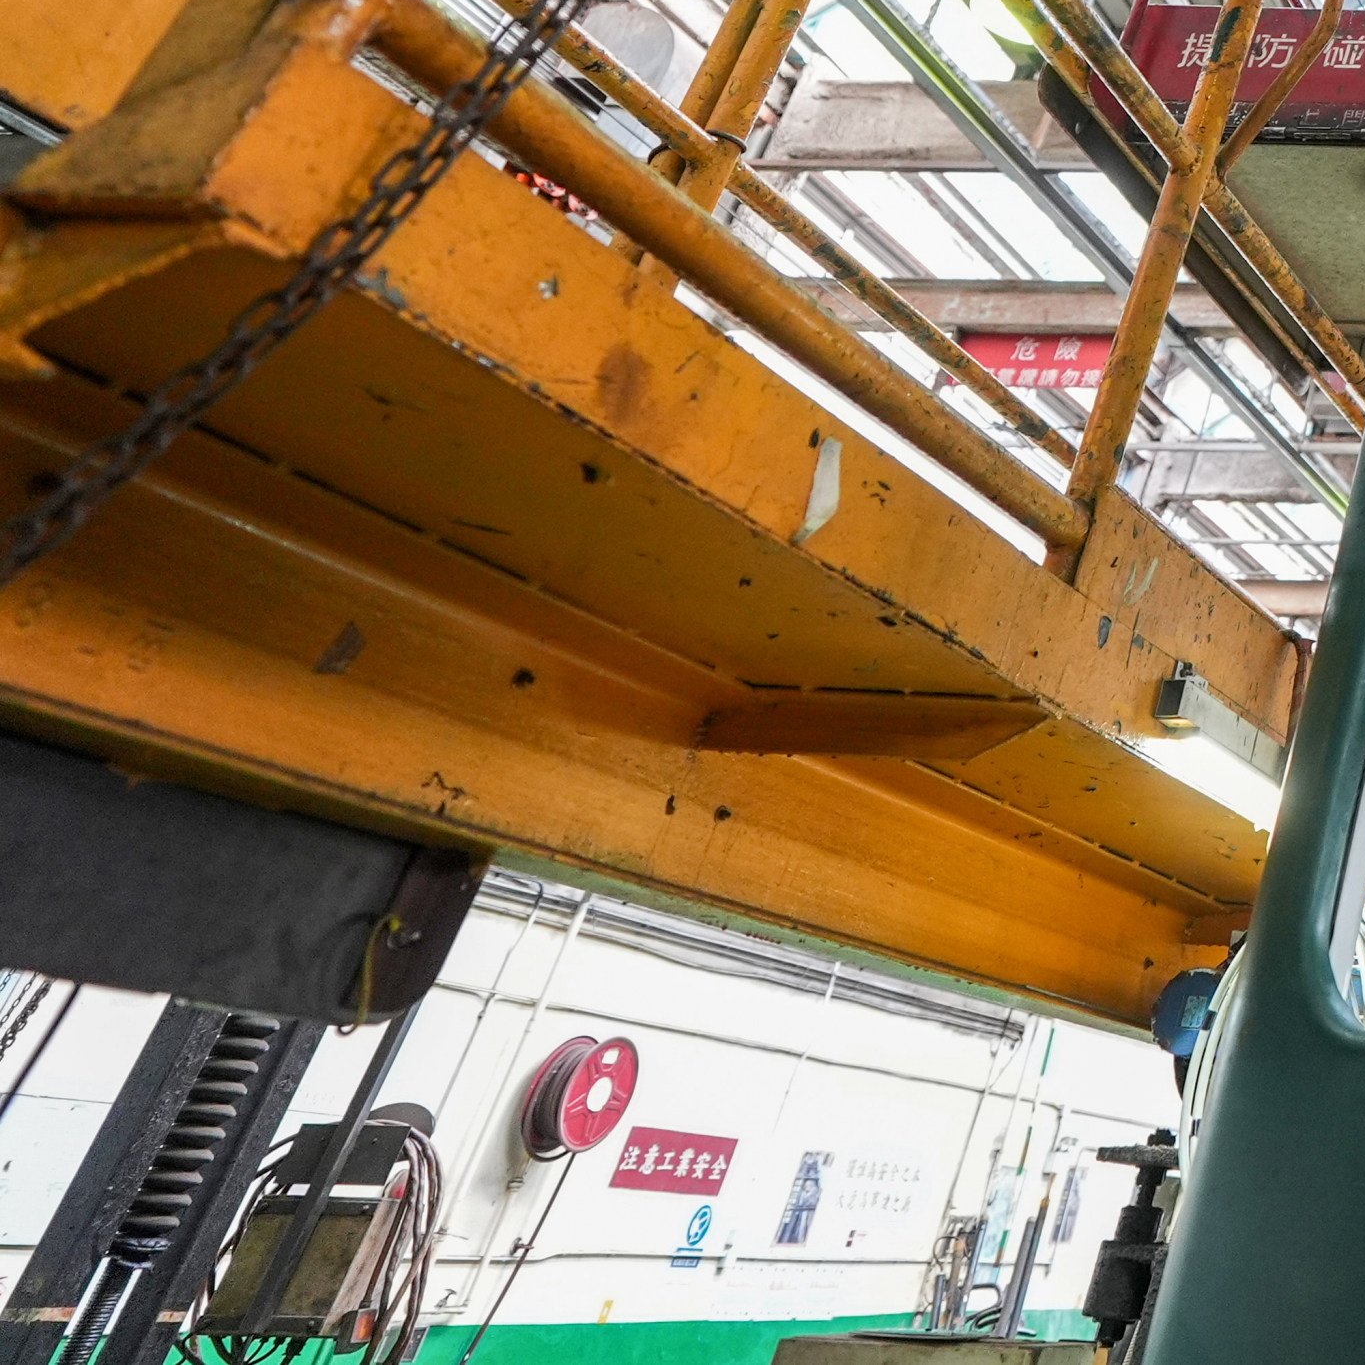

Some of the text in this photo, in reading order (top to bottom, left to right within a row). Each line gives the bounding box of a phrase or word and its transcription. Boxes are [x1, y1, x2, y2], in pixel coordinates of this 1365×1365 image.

[1010, 337, 1083, 361] 危險
[619, 1144, 727, 1180] 注意工業安全
